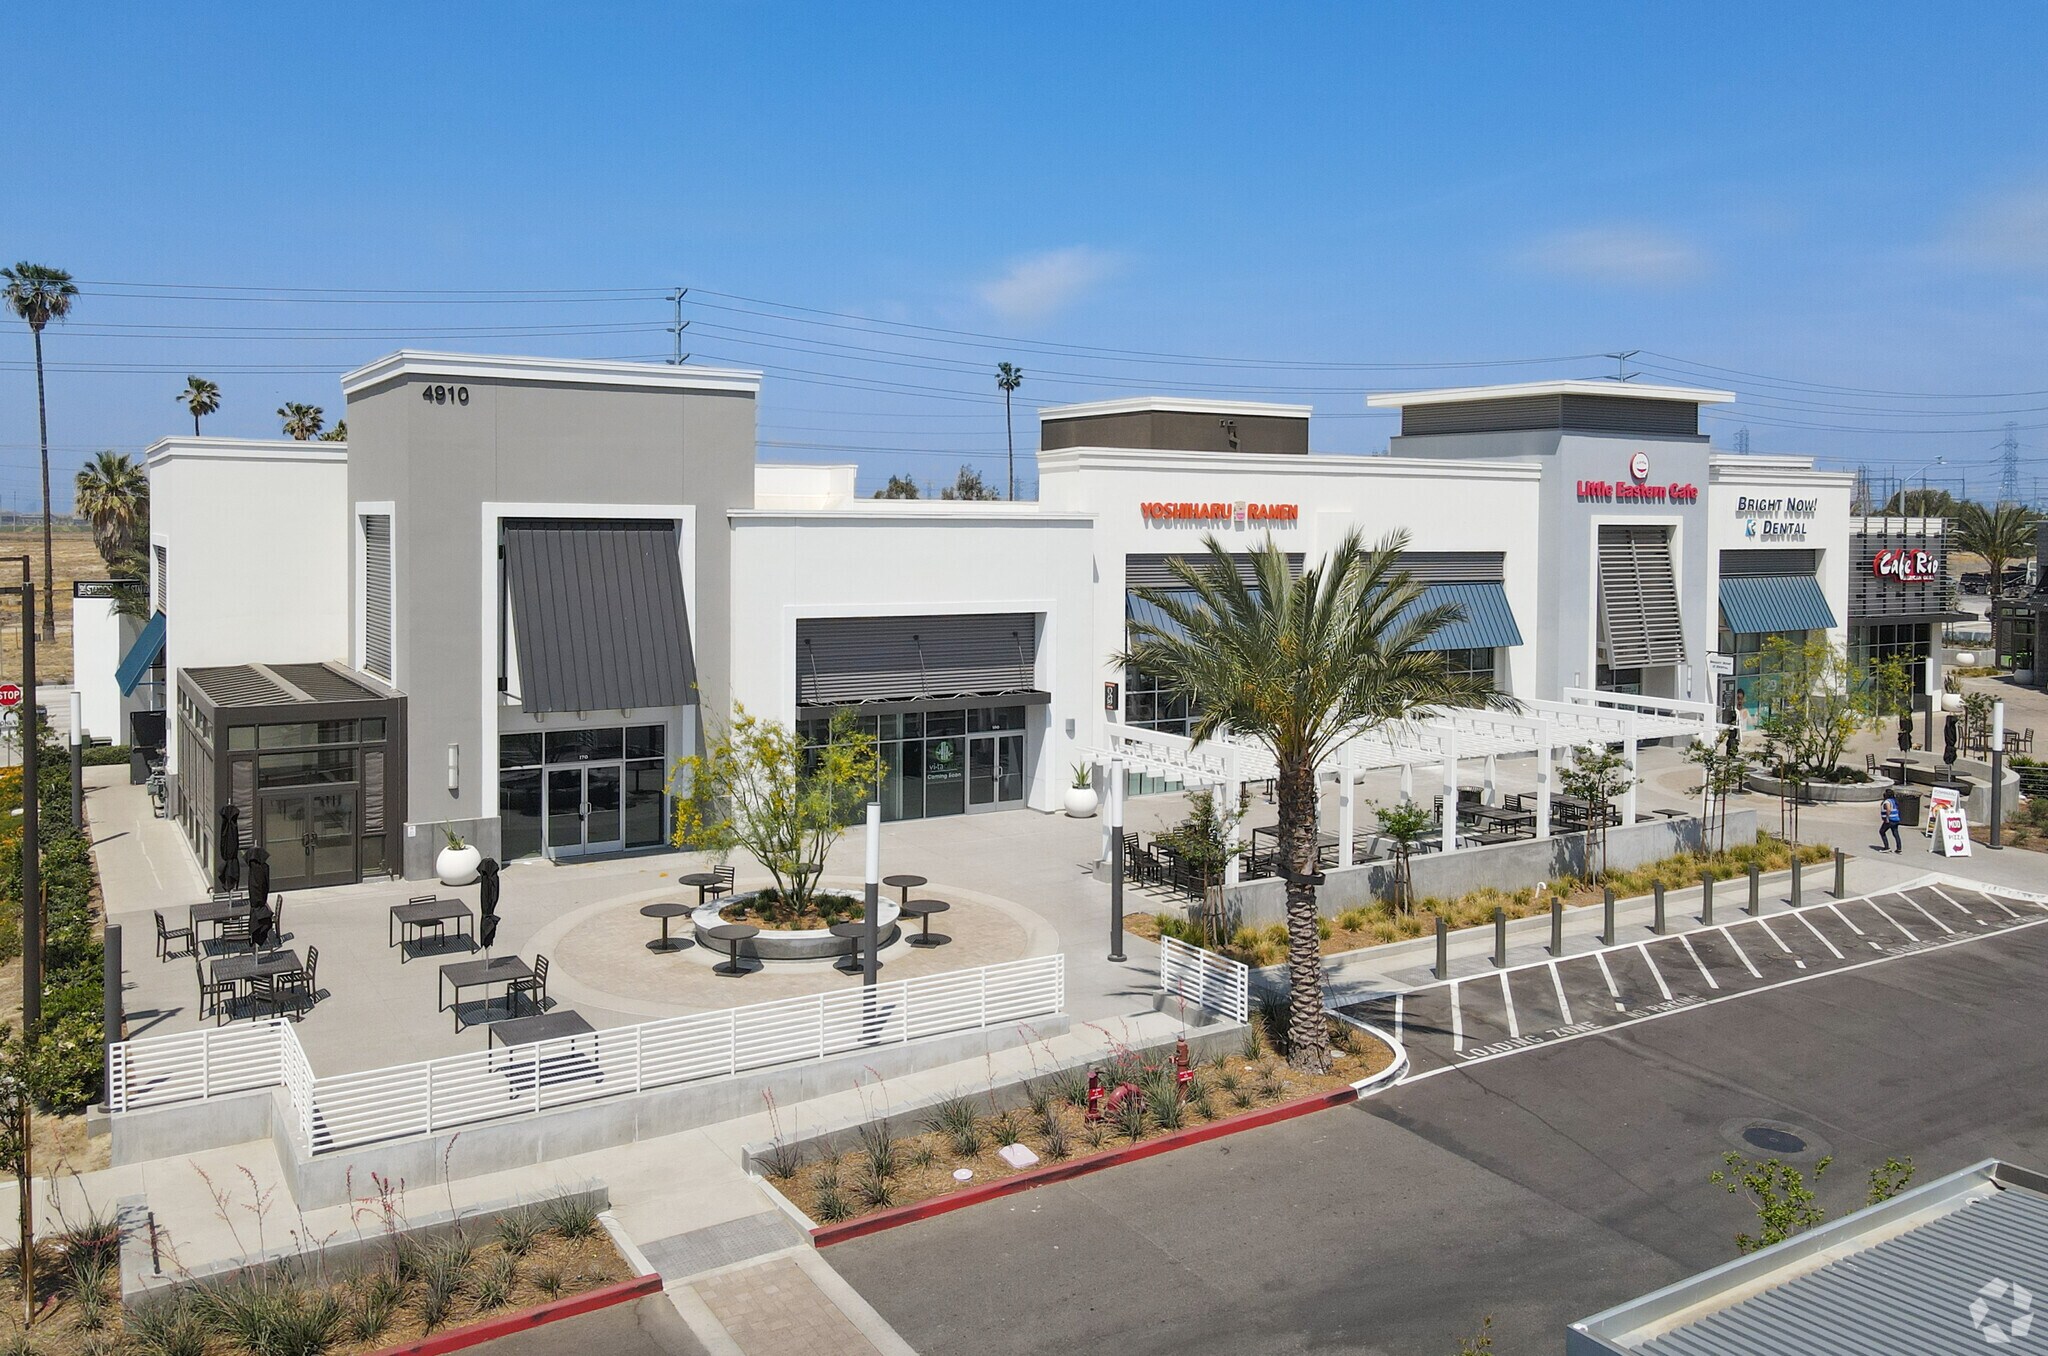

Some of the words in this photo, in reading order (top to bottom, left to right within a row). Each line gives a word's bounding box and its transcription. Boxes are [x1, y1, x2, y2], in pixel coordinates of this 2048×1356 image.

[422, 384, 469, 406] 4910
[1576, 480, 1614, 498] Little
[1615, 481, 1667, 499] Eastern
[1668, 482, 1699, 499] Cafe
[1140, 502, 1232, 520] YOSHIHARU
[1247, 503, 1298, 521] RAMEN
[1738, 496, 1783, 512] BRIGHT
[1786, 497, 1818, 512] NOW!
[1763, 520, 1807, 535] DENTAL
[1880, 551, 1911, 580] Cafe
[1916, 551, 1939, 574] Rio
[0, 691, 20, 700] STOP
[1646, 995, 1707, 1013] PARKING
[1456, 1034, 1544, 1060] LOADING
[1546, 1021, 1603, 1038] ZONE
